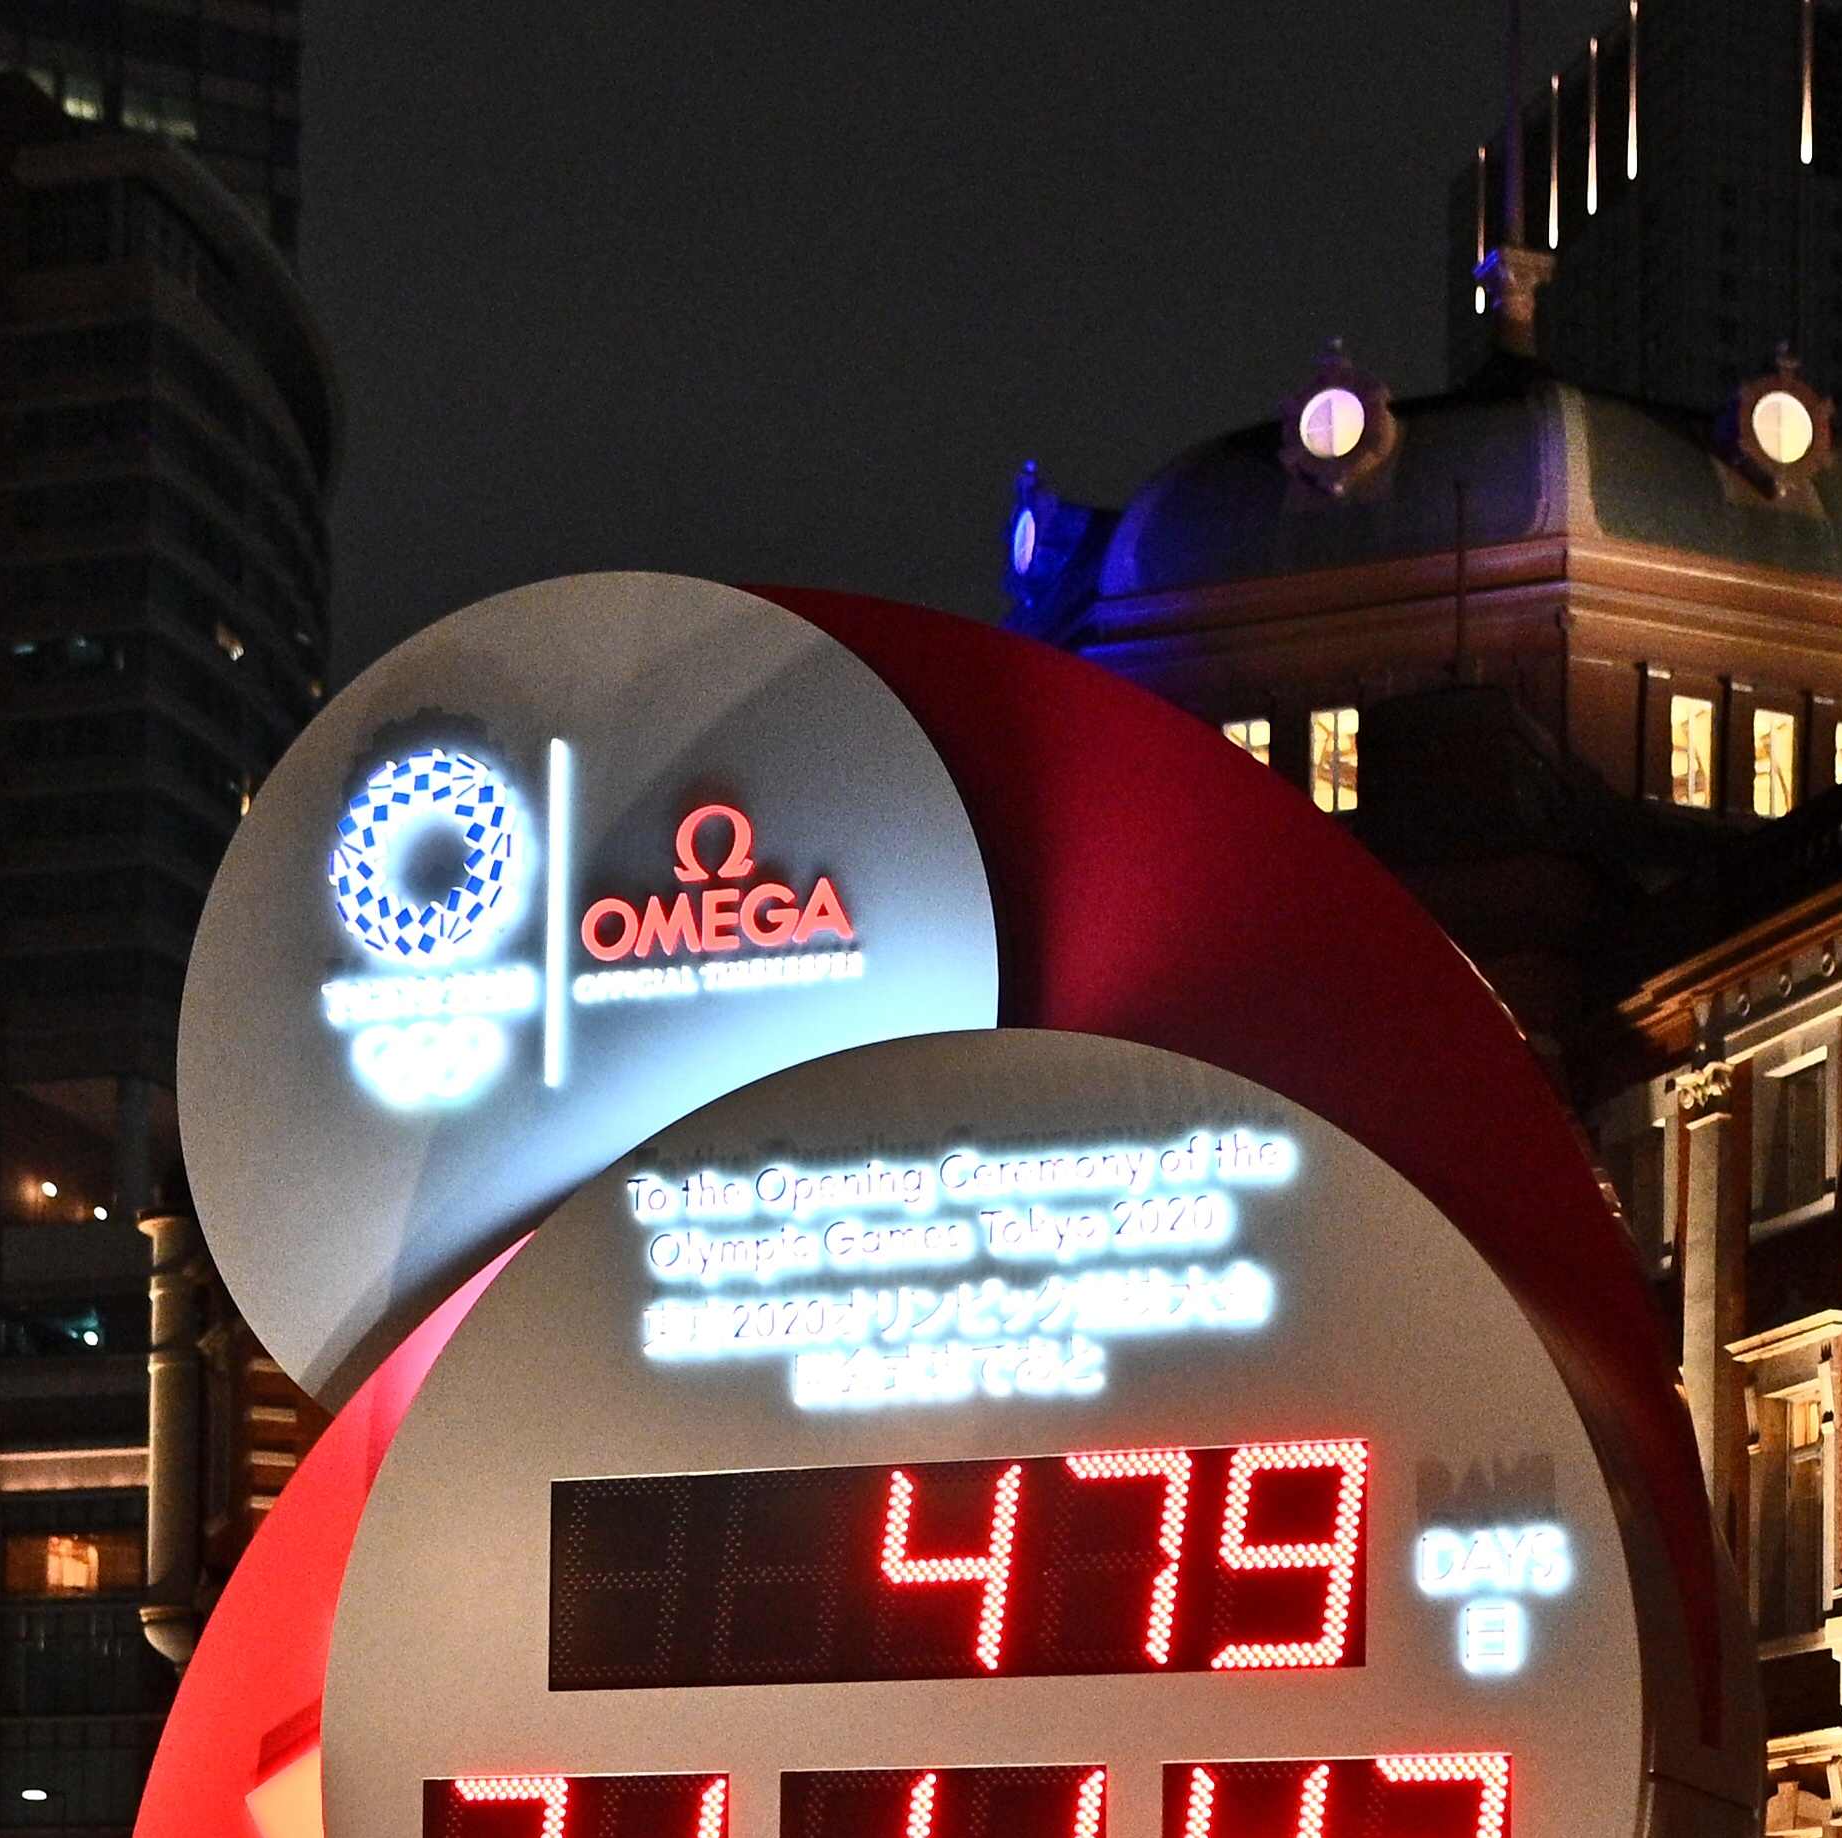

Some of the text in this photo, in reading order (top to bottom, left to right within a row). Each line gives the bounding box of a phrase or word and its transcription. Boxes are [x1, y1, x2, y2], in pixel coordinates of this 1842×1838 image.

[581, 877, 854, 962] OMEGA
[626, 1128, 1295, 1221] To the Opening Ceremony of the
[648, 1193, 1232, 1284] Olympic Games Tokyo 2020
[880, 1441, 1369, 1670] 479
[1416, 1525, 1570, 1596] DAYS
[1461, 1599, 1524, 1674] 日
